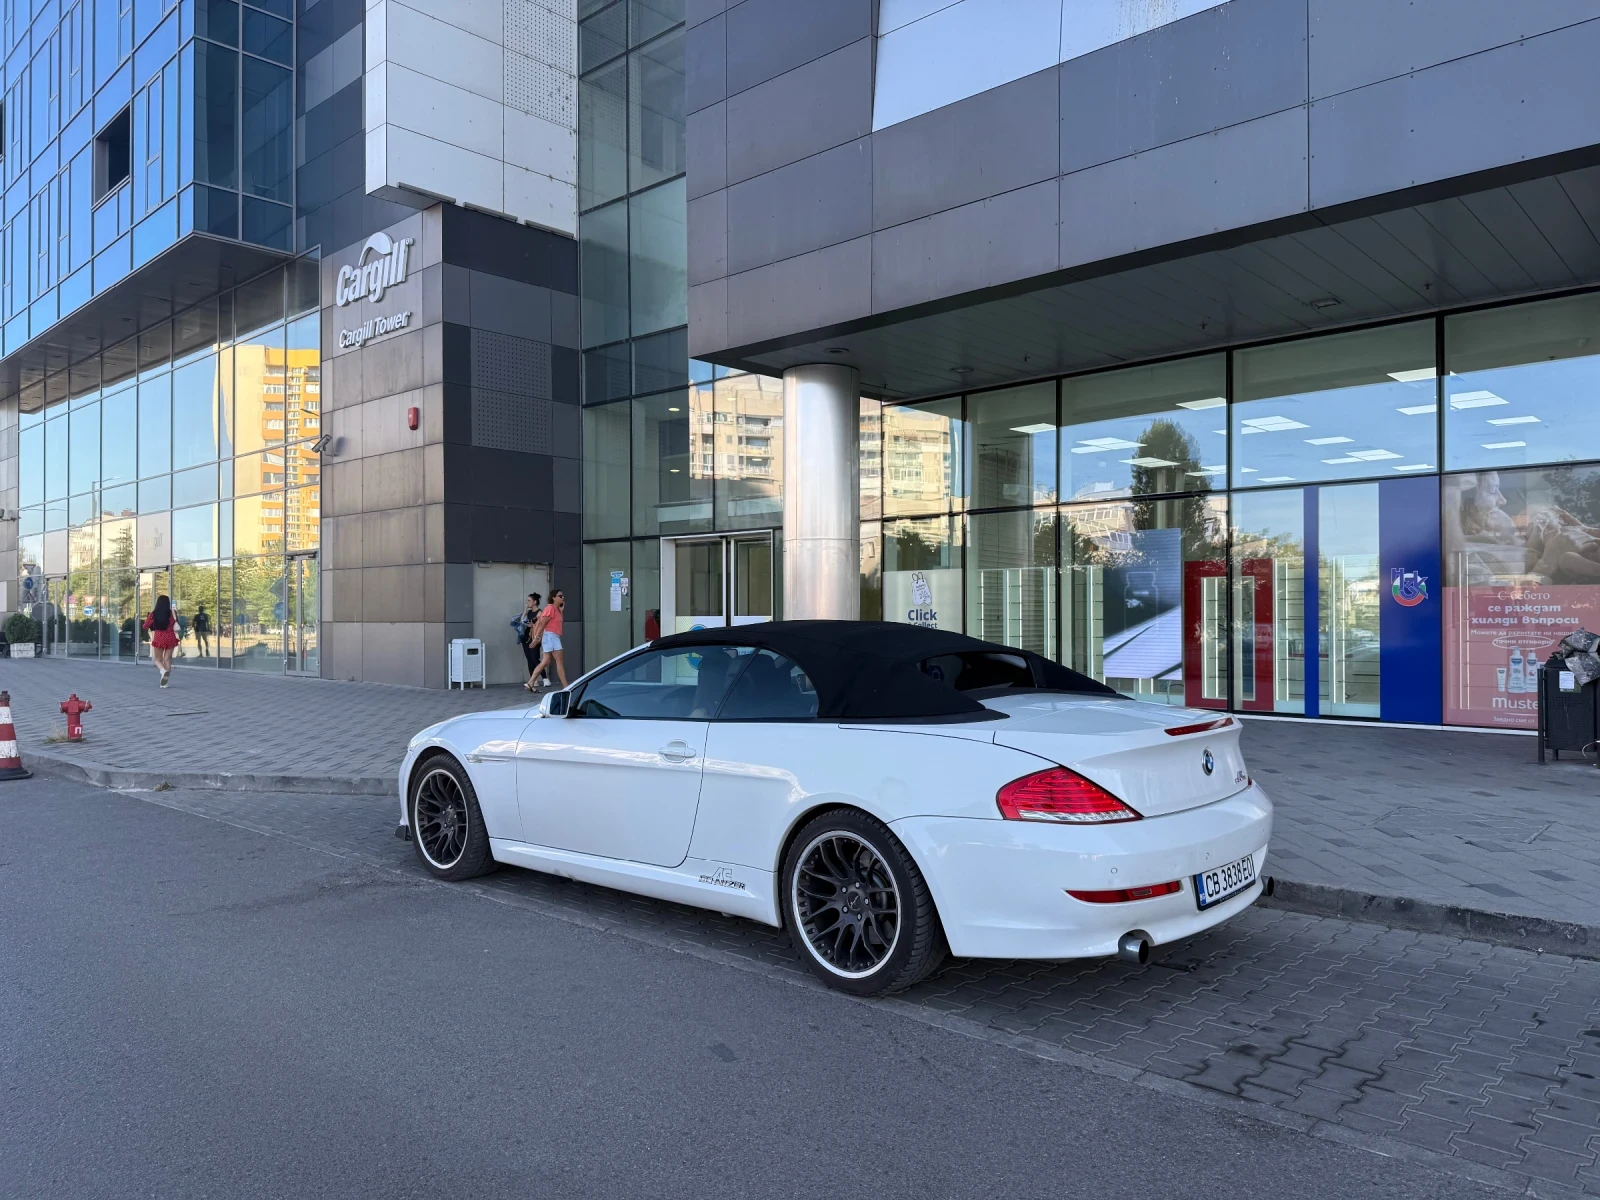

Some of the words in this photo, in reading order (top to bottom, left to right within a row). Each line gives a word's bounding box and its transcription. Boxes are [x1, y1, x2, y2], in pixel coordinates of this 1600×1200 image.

[336, 238, 410, 306] Cargill
[339, 320, 375, 348] Cargill
[374, 311, 411, 335] Tower
[1510, 590, 1550, 600] бебето
[908, 609, 938, 621] Click
[1487, 604, 1501, 612] се
[1505, 604, 1561, 614] раждат
[1471, 617, 1518, 626] хиляди
[1522, 616, 1579, 626] въпроси
[1492, 697, 1538, 710] Muste
[1205, 871, 1221, 898] CB
[1221, 862, 1243, 892] 3838
